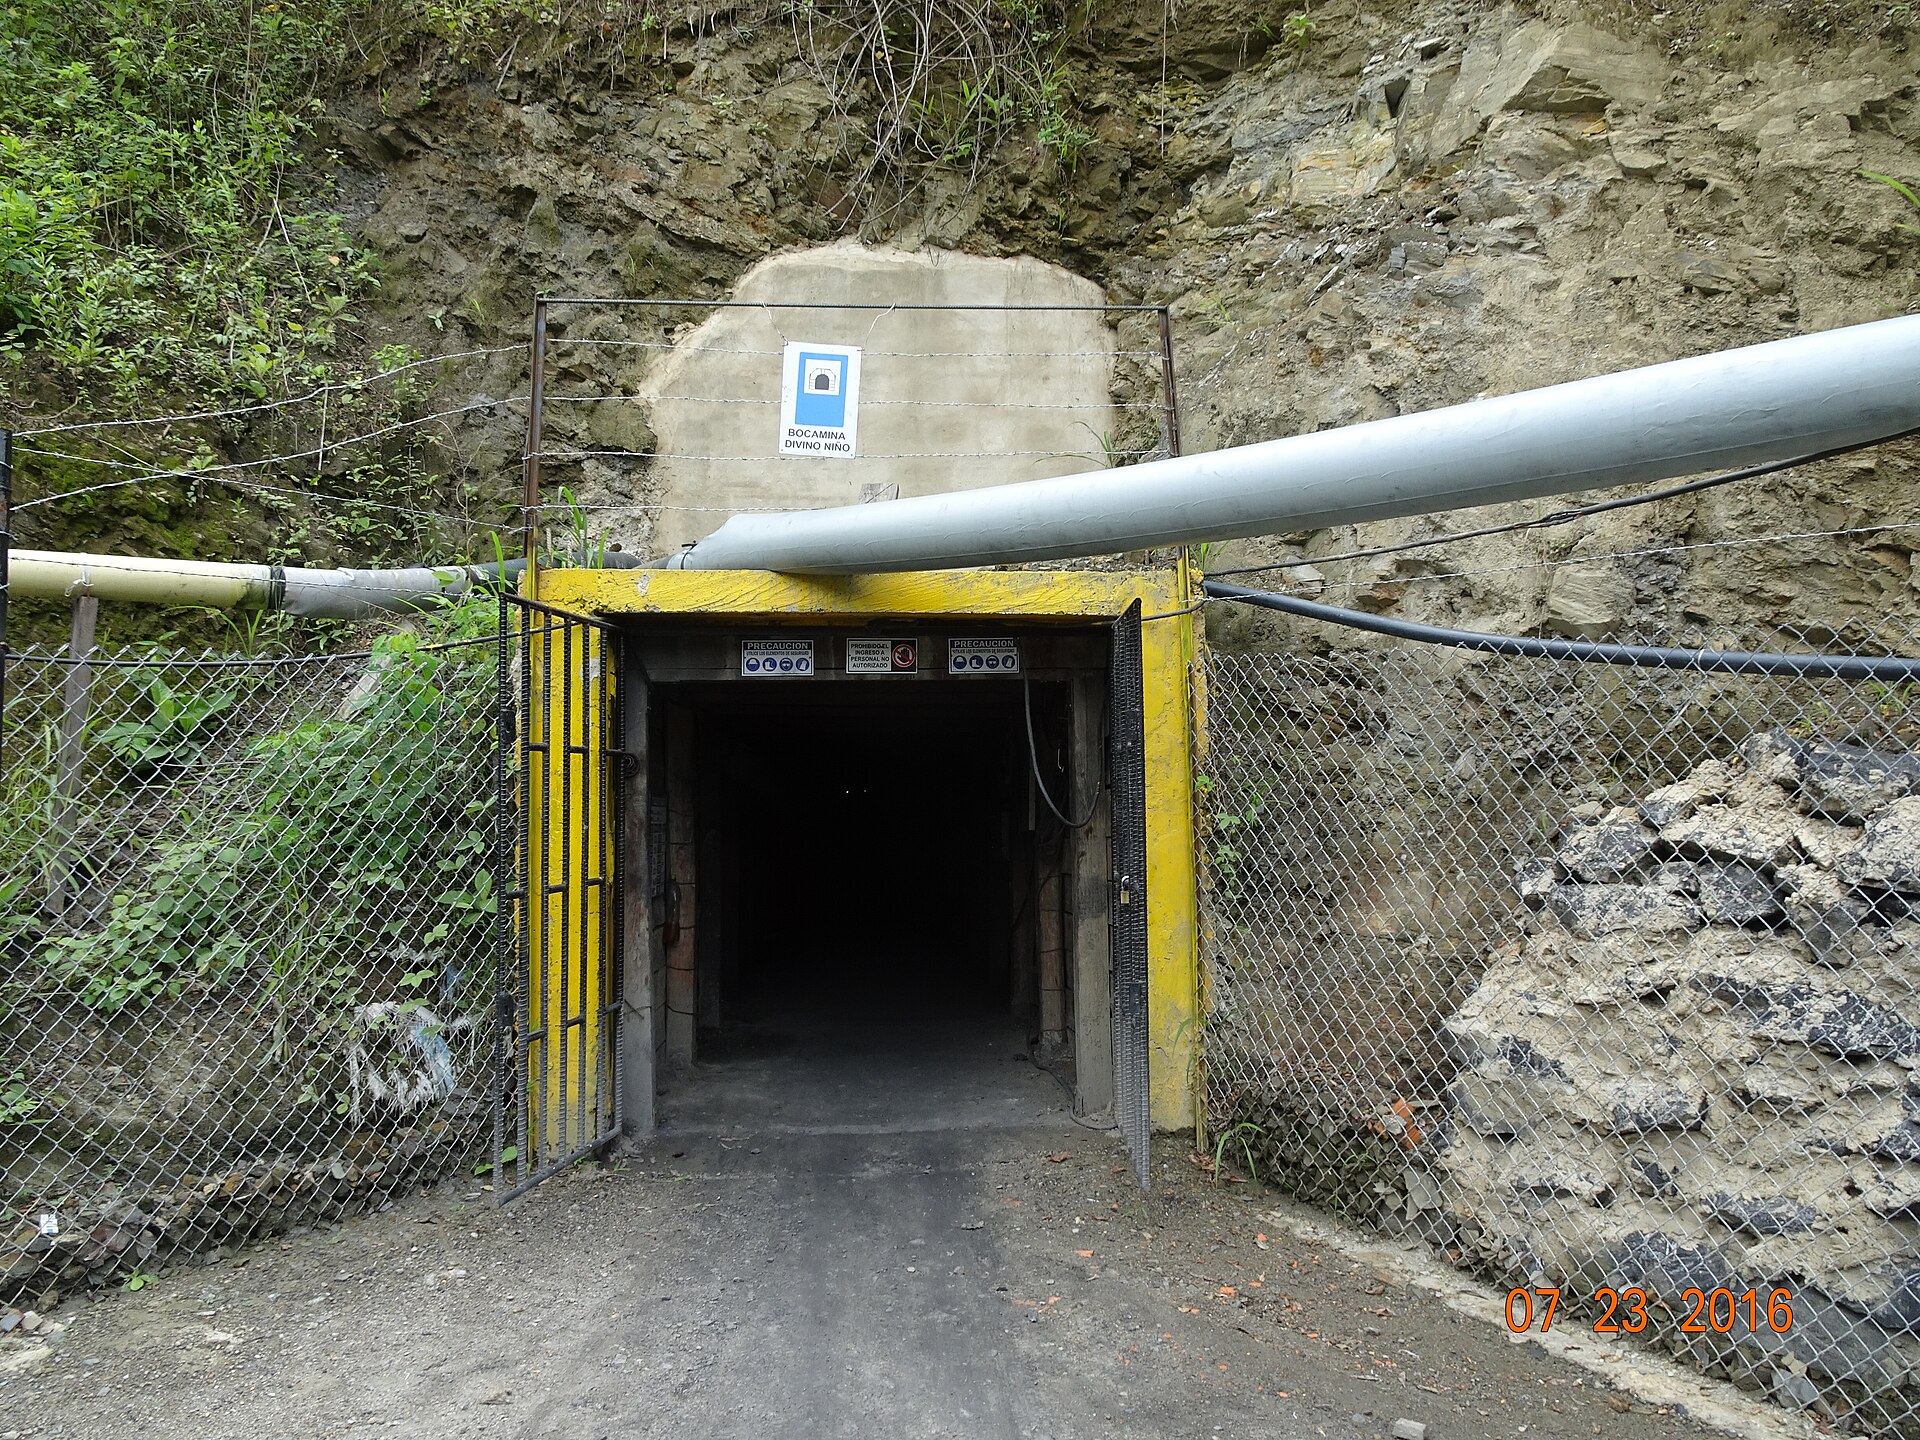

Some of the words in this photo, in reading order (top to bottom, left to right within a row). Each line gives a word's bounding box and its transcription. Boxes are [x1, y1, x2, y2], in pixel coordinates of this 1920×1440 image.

[788, 428, 846, 440] BOCAMINA
[785, 439, 821, 450] DIVINO
[824, 441, 850, 452] NIÑO
